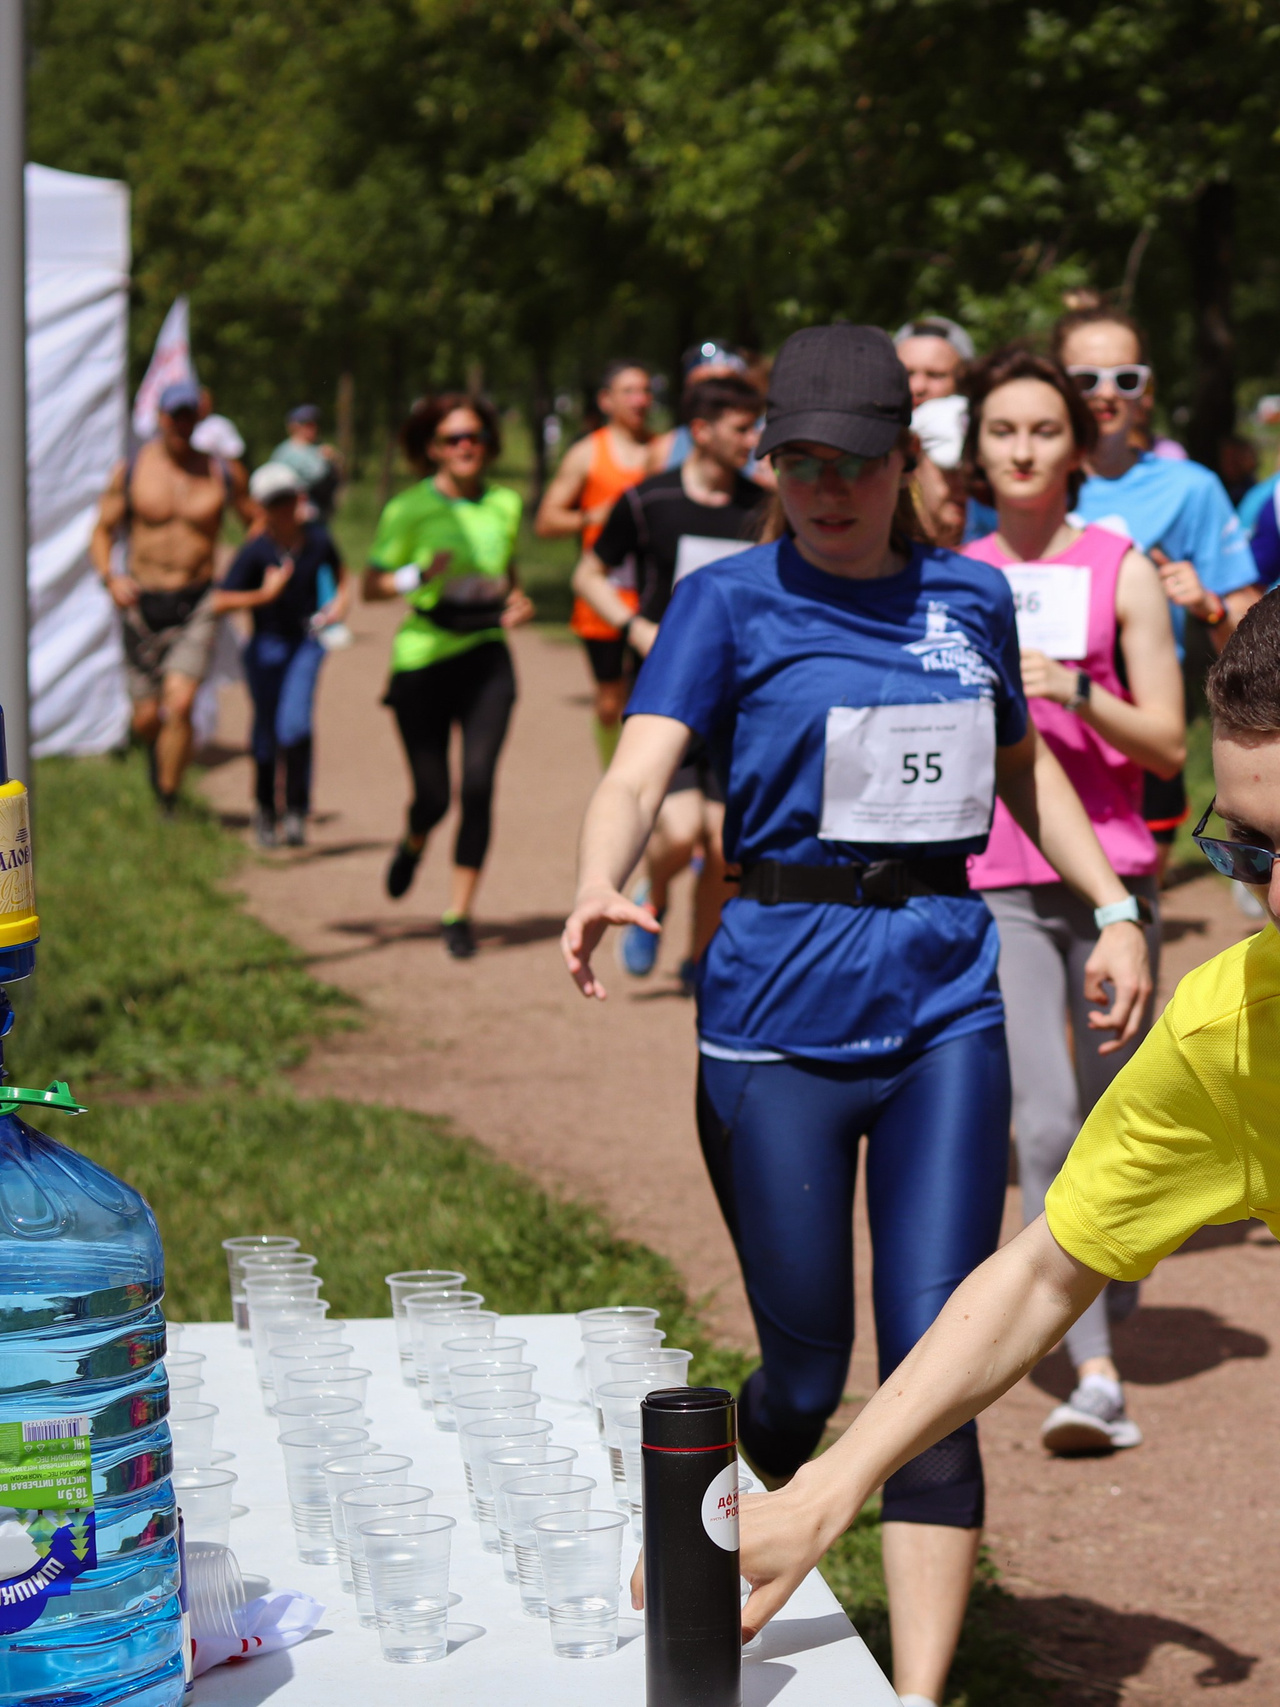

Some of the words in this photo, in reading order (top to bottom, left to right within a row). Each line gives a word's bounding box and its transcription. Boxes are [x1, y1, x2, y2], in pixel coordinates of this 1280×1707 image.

[902, 752, 943, 784] 55
[11, 1479, 54, 1491] ПИТЬЕВАЯ
[56, 1476, 87, 1486] ЧИСТАЯ
[0, 1556, 66, 1607] ШИШК
